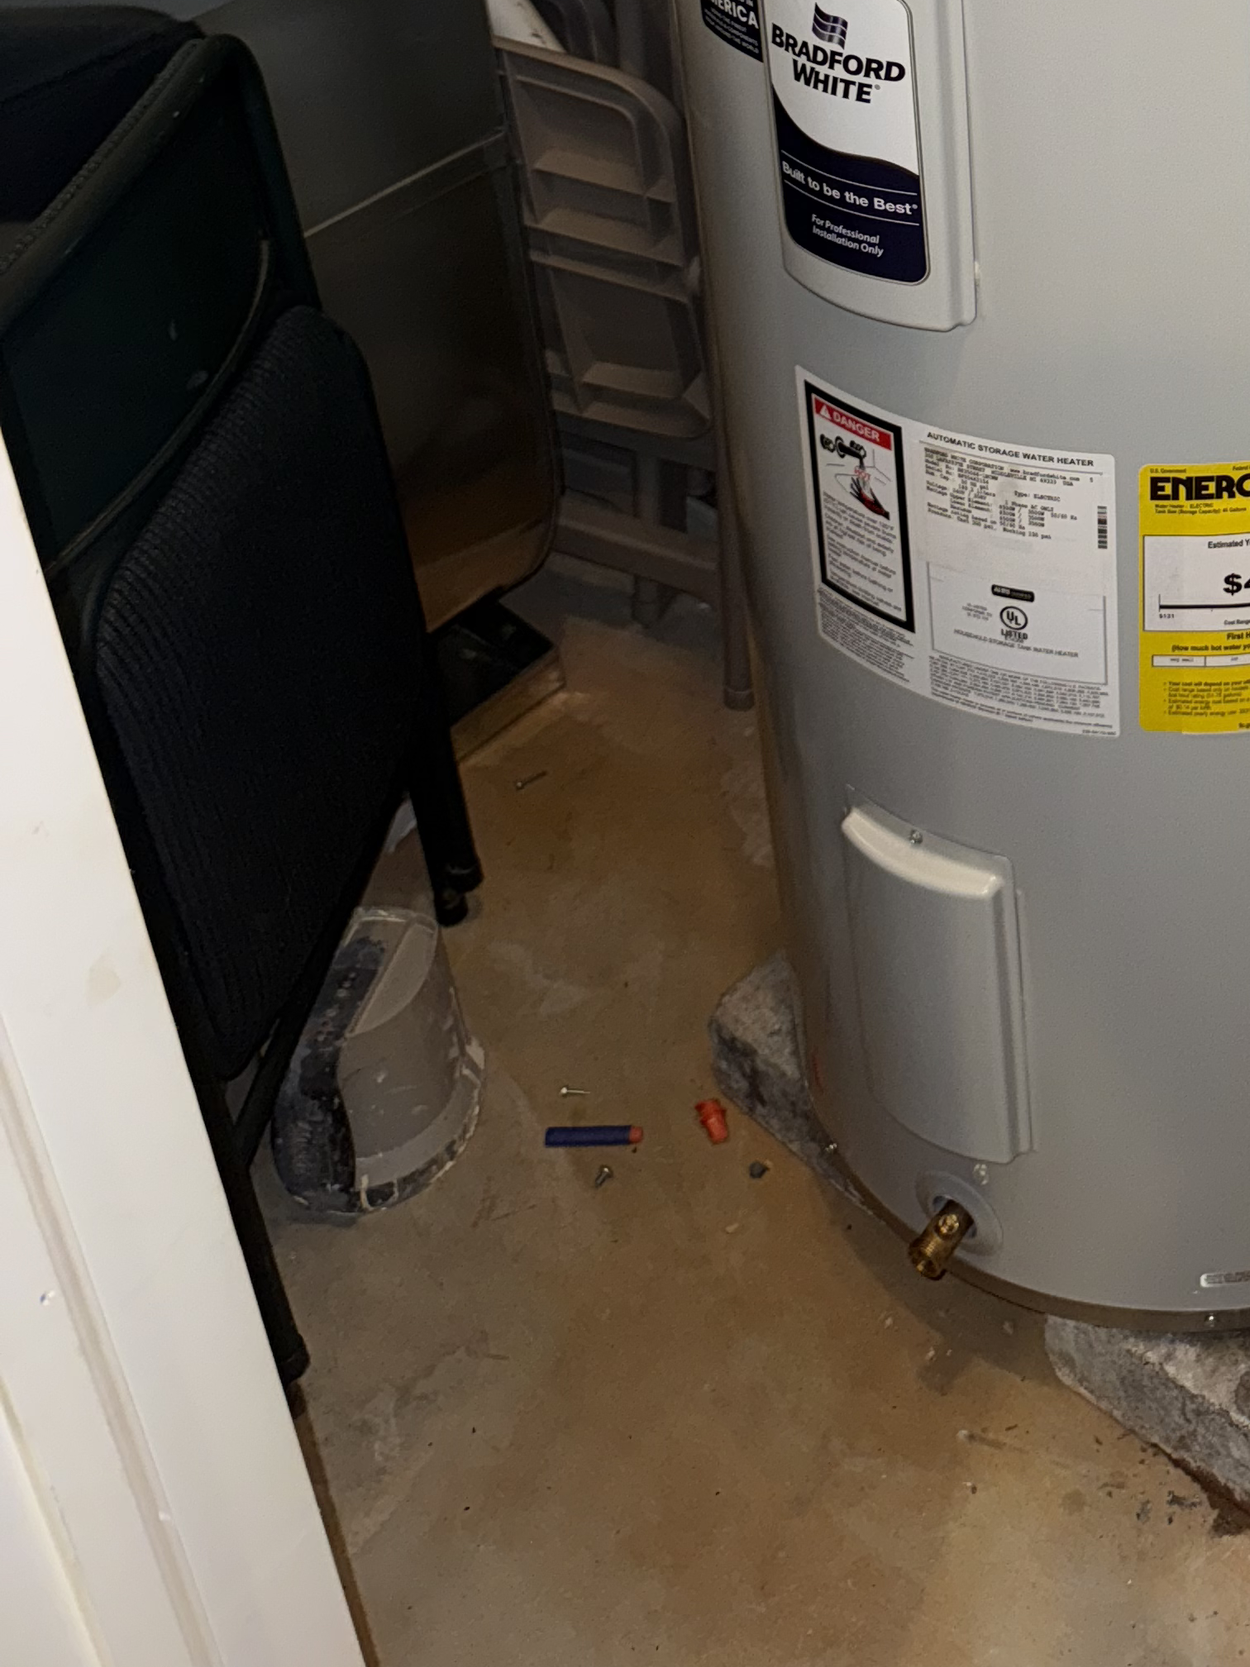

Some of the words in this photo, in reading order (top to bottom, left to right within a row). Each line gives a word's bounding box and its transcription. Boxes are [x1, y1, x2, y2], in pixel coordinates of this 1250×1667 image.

[771, 23, 905, 83] BRADFORD
[792, 58, 872, 103] WHITE
[782, 161, 805, 184] Built
[807, 172, 820, 189] to
[823, 180, 840, 199] be
[844, 188, 869, 207] the
[874, 197, 912, 216] Best
[811, 214, 824, 227] For
[825, 218, 880, 244] Professional
[812, 225, 859, 250] Installation
[860, 241, 884, 258] Only
[833, 411, 880, 442] DANGER
[927, 432, 976, 450] AUTOMATIC
[977, 444, 1020, 458] STORAGE
[1022, 452, 1055, 463] WATER
[1057, 457, 1094, 467] HEATER
[1208, 538, 1243, 549] Estimated
[1001, 628, 1028, 641] LISTED
